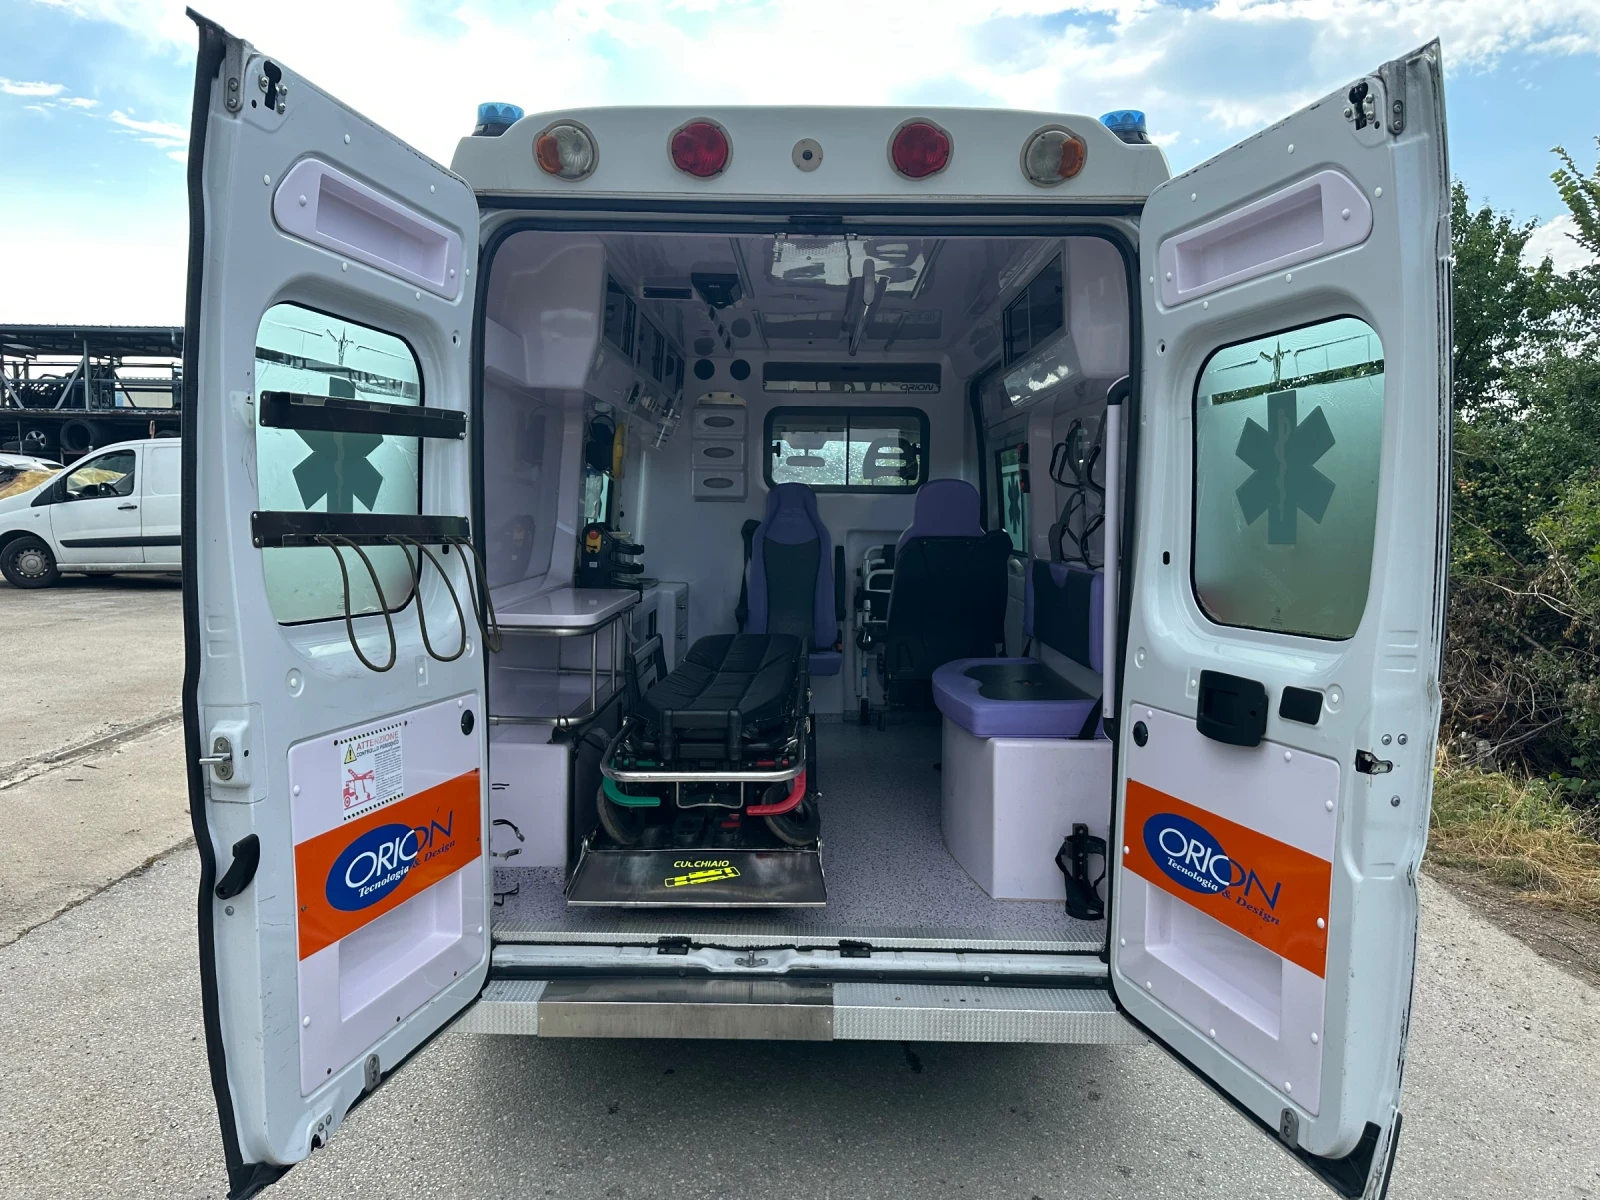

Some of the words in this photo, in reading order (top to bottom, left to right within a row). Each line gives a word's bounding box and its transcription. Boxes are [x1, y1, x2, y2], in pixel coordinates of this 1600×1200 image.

[900, 383, 934, 391] ORION
[356, 730, 399, 751] ATTENZIONE
[356, 745, 379, 758] CONTROLLO
[345, 810, 453, 889] ORION
[358, 865, 410, 898] Tecnologia
[424, 839, 456, 864] Design
[1158, 827, 1282, 911] ORION
[1167, 856, 1219, 892] Tecnologia
[1221, 889, 1232, 901] &
[1236, 896, 1281, 926] Design
